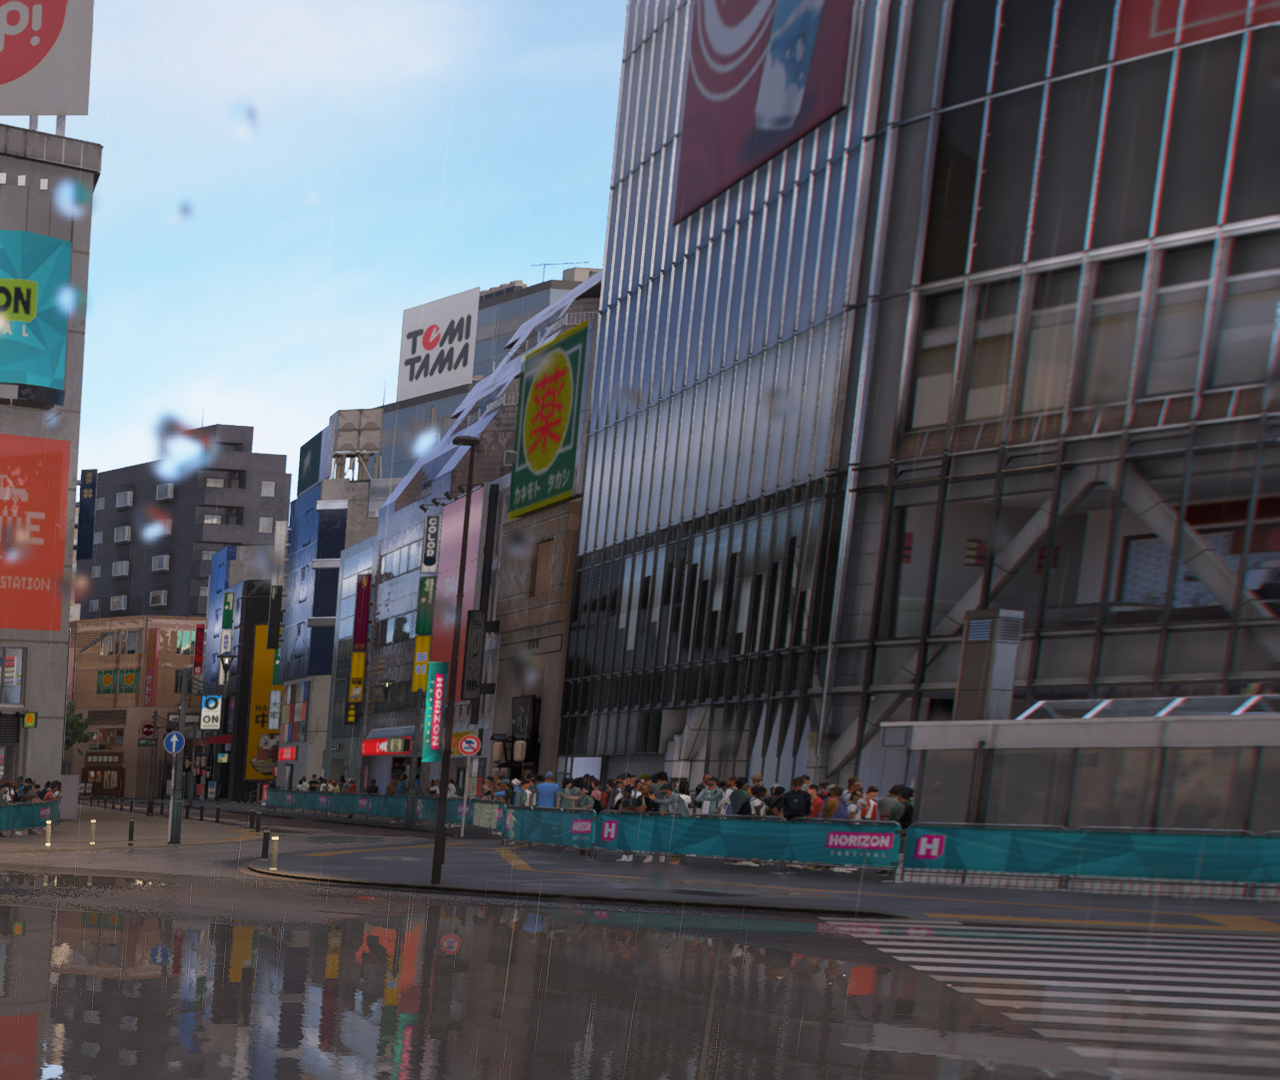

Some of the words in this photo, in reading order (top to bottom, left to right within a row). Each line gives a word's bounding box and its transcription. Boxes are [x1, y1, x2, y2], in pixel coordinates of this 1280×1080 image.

[406, 314, 472, 355] TOMI
[404, 342, 470, 382] TAMA
[528, 365, 567, 456] 薬
[426, 517, 438, 558] COLOR
[0, 575, 51, 591] STATION
[203, 715, 219, 724] ON
[431, 676, 444, 748] HORIZON
[603, 823, 617, 839] H
[827, 833, 892, 849] HORIZON
[917, 837, 942, 858] H
